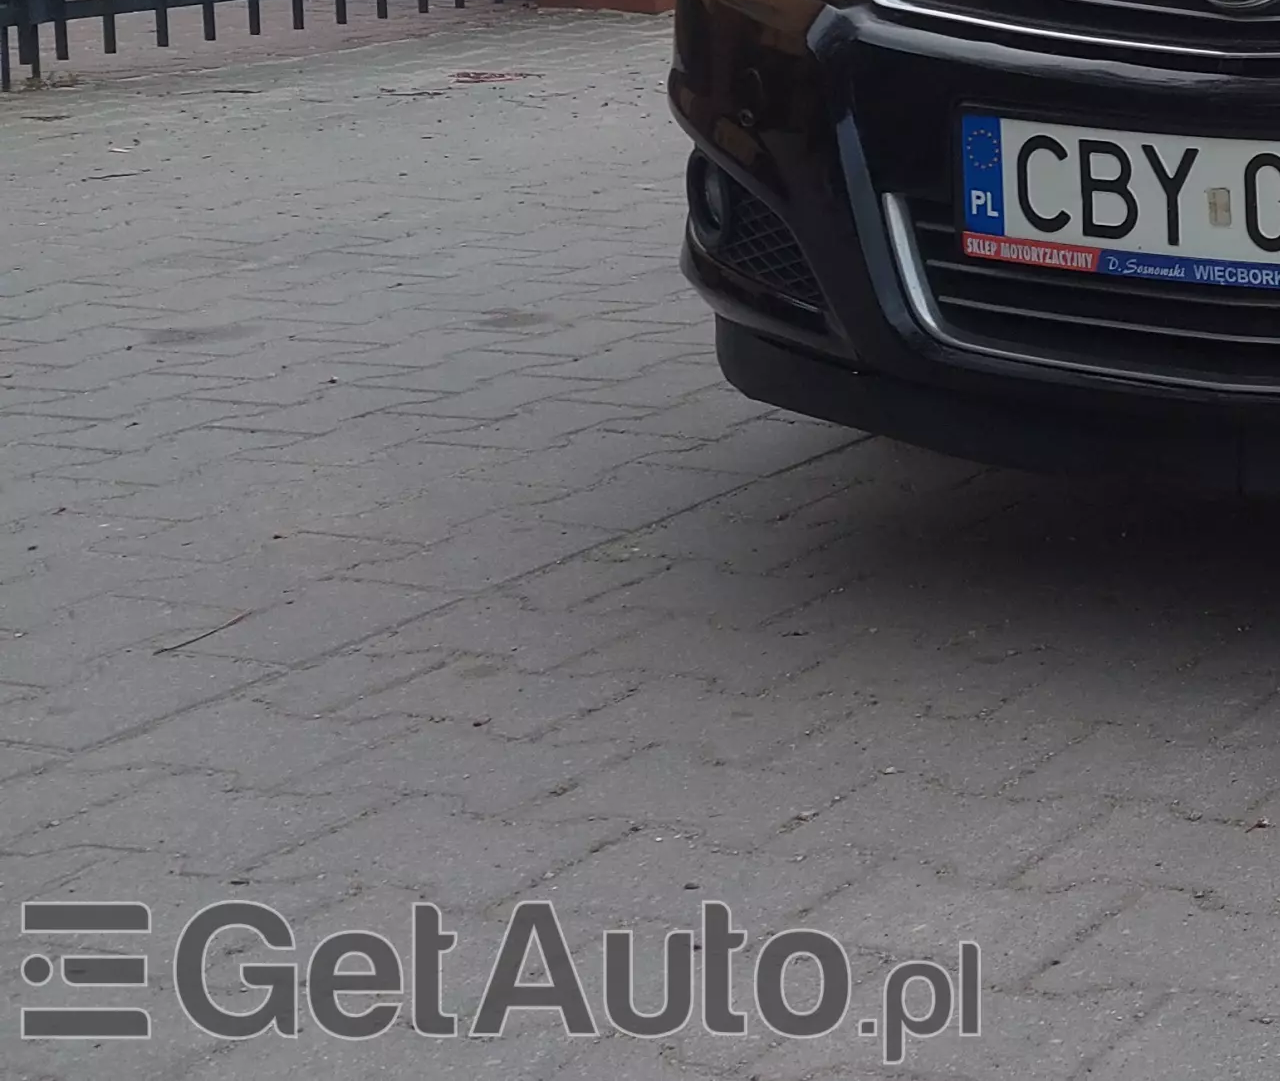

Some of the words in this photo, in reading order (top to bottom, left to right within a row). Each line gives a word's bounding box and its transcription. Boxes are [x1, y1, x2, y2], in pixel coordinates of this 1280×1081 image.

[970, 189, 999, 218] PL
[1016, 134, 1200, 247] CBY
[966, 238, 997, 257] SKLEP
[1000, 242, 1093, 269] MOTORYZACYJNY
